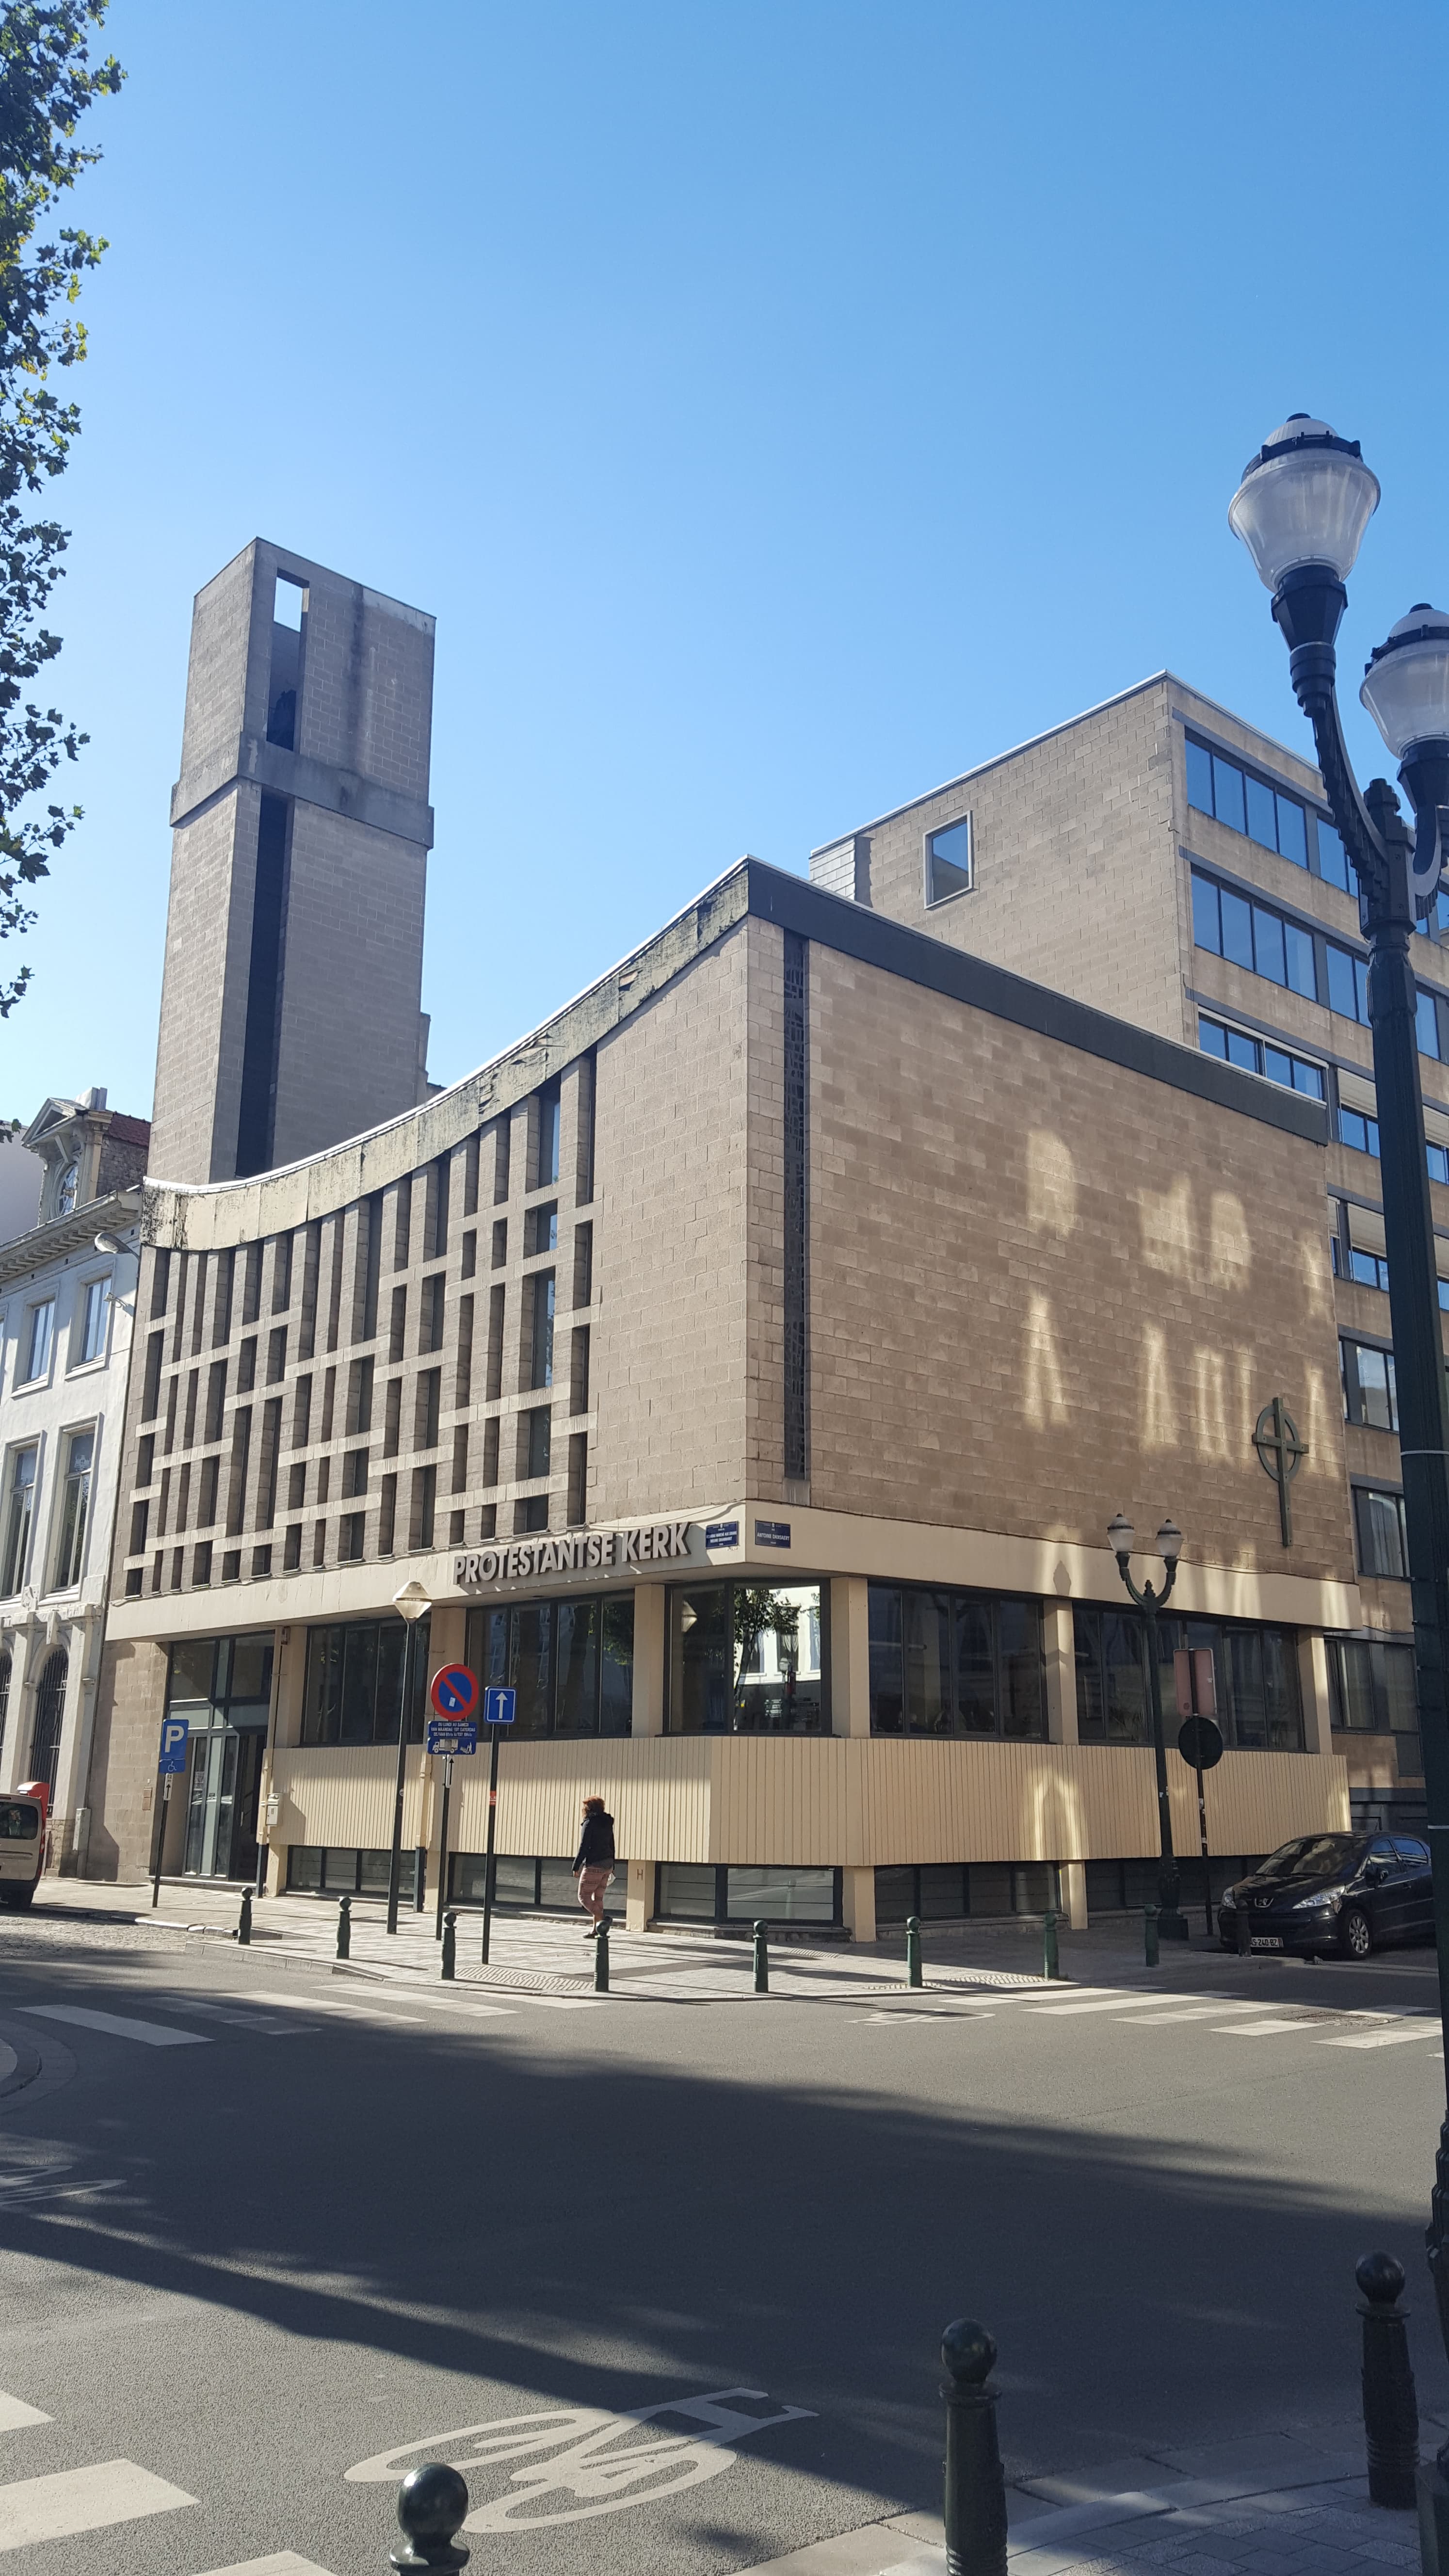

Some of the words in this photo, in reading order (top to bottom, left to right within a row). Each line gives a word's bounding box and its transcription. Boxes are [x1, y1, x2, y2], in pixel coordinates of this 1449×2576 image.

[453, 1533, 616, 1584] PROTESTANTSE
[622, 1522, 691, 1562] KERK
[165, 1725, 184, 1753] P
[637, 1869, 643, 1881] H
